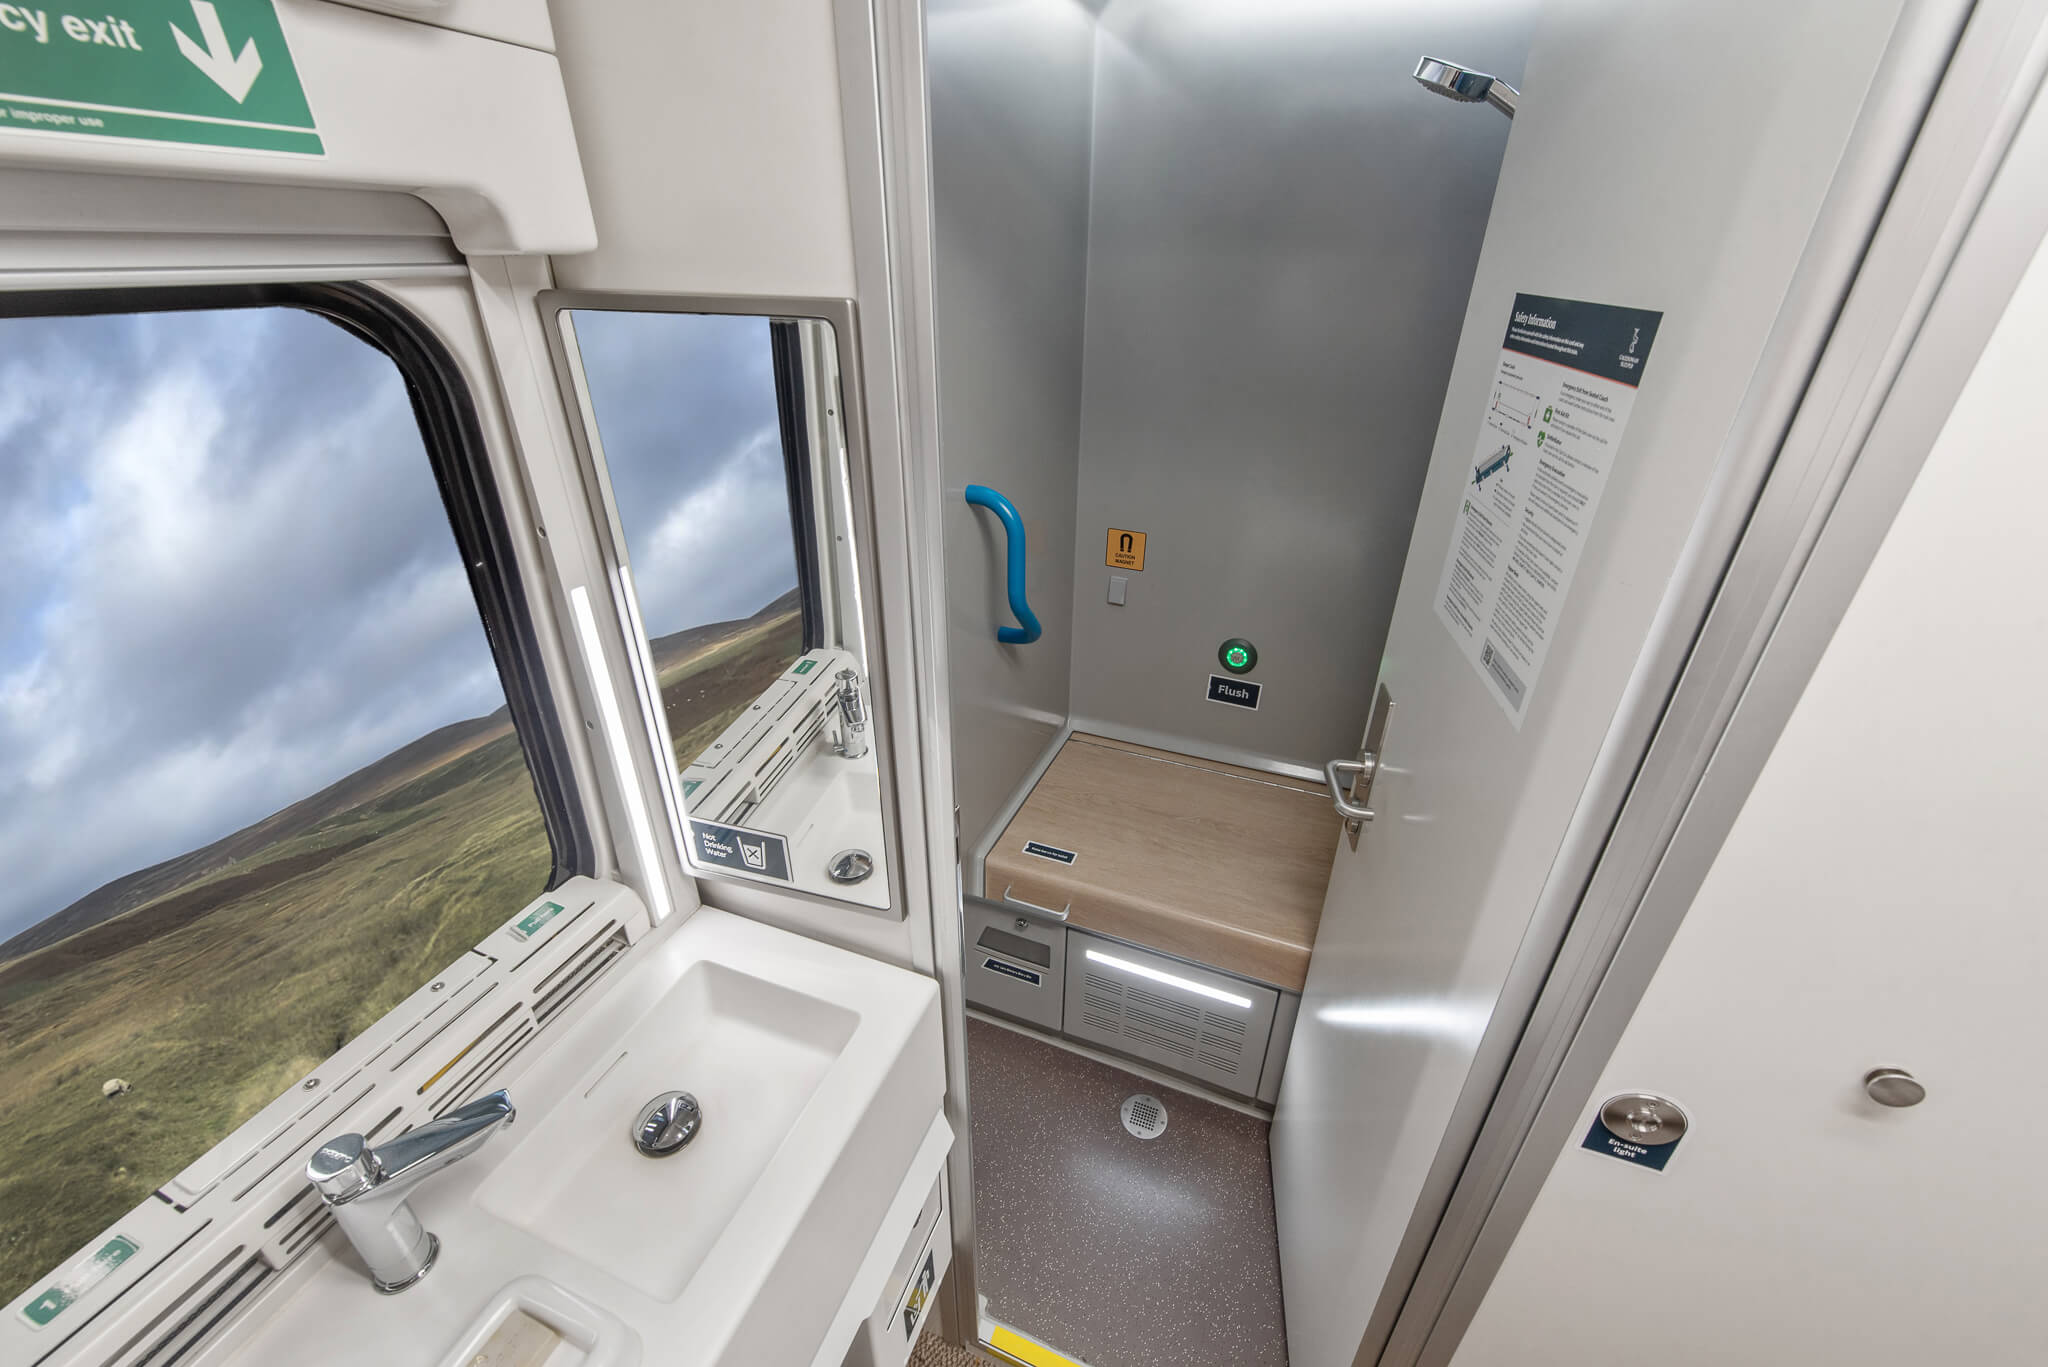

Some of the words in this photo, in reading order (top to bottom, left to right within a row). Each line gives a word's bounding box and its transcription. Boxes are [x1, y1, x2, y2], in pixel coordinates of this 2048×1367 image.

[61, 14, 143, 51] exit
[8, 106, 76, 125] improper
[77, 116, 104, 128] use
[1514, 311, 1528, 326] Safety
[1527, 313, 1557, 330] Information
[1114, 552, 1136, 561] CAUTION
[1114, 558, 1135, 567] MAGNET
[1218, 684, 1249, 700] Flush
[702, 832, 716, 841] Not
[703, 840, 733, 854] Drinking
[705, 848, 727, 858] Water
[1608, 1138, 1648, 1155] En-suite
[1613, 1146, 1636, 1159] light
